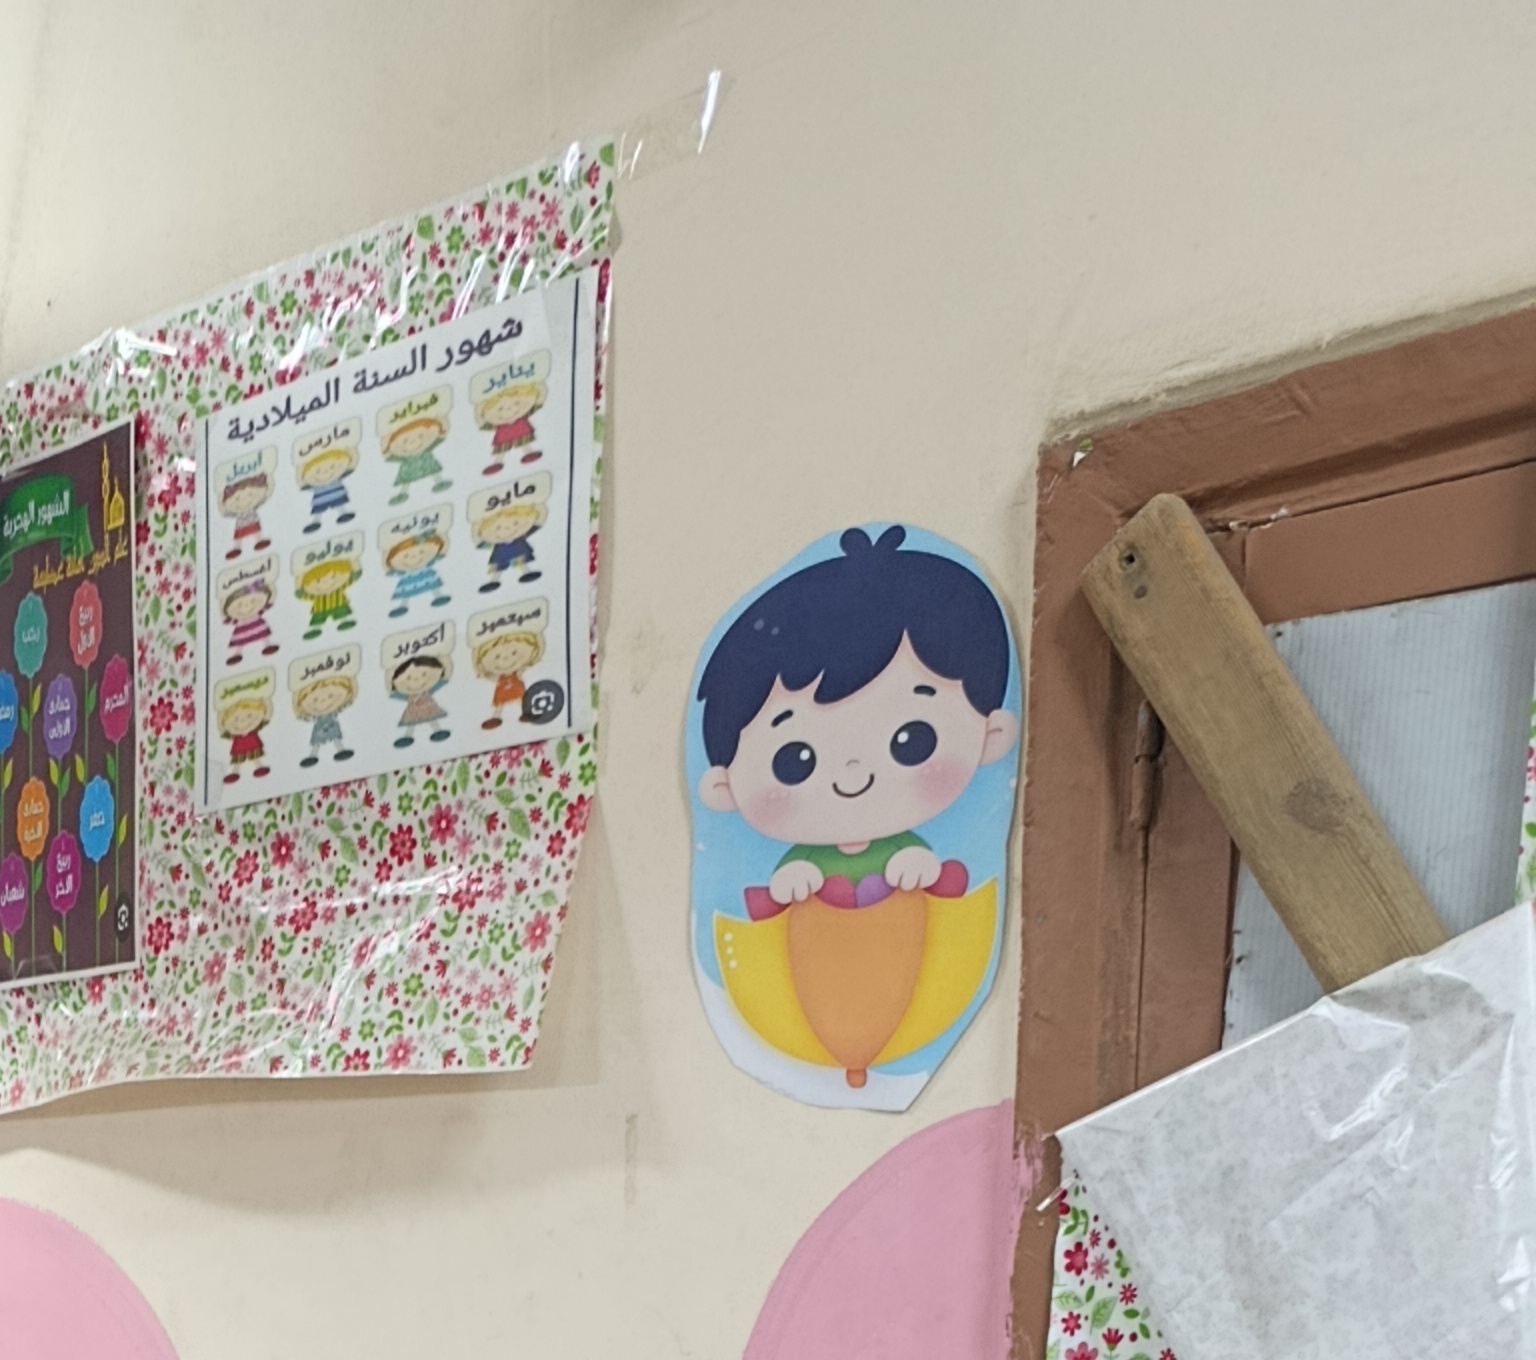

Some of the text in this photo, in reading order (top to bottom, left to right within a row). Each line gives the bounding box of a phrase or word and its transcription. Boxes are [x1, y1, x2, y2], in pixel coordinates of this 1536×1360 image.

[226, 318, 524, 443] شهور السنة الميلادية
[481, 362, 535, 393] يناير
[388, 393, 440, 424] فبراير
[298, 425, 351, 456] مارس
[485, 480, 537, 512] مايو
[2, 490, 70, 539] الشهور الهجرية
[304, 538, 353, 565] يوليو
[78, 605, 94, 627] ربيع
[21, 626, 41, 643] رجب
[299, 651, 352, 680] نوفمبر
[220, 676, 269, 700] ديسمبر
[89, 809, 106, 831] صفر
[56, 853, 72, 874] ربيع
[0, 881, 25, 908] شعبان
